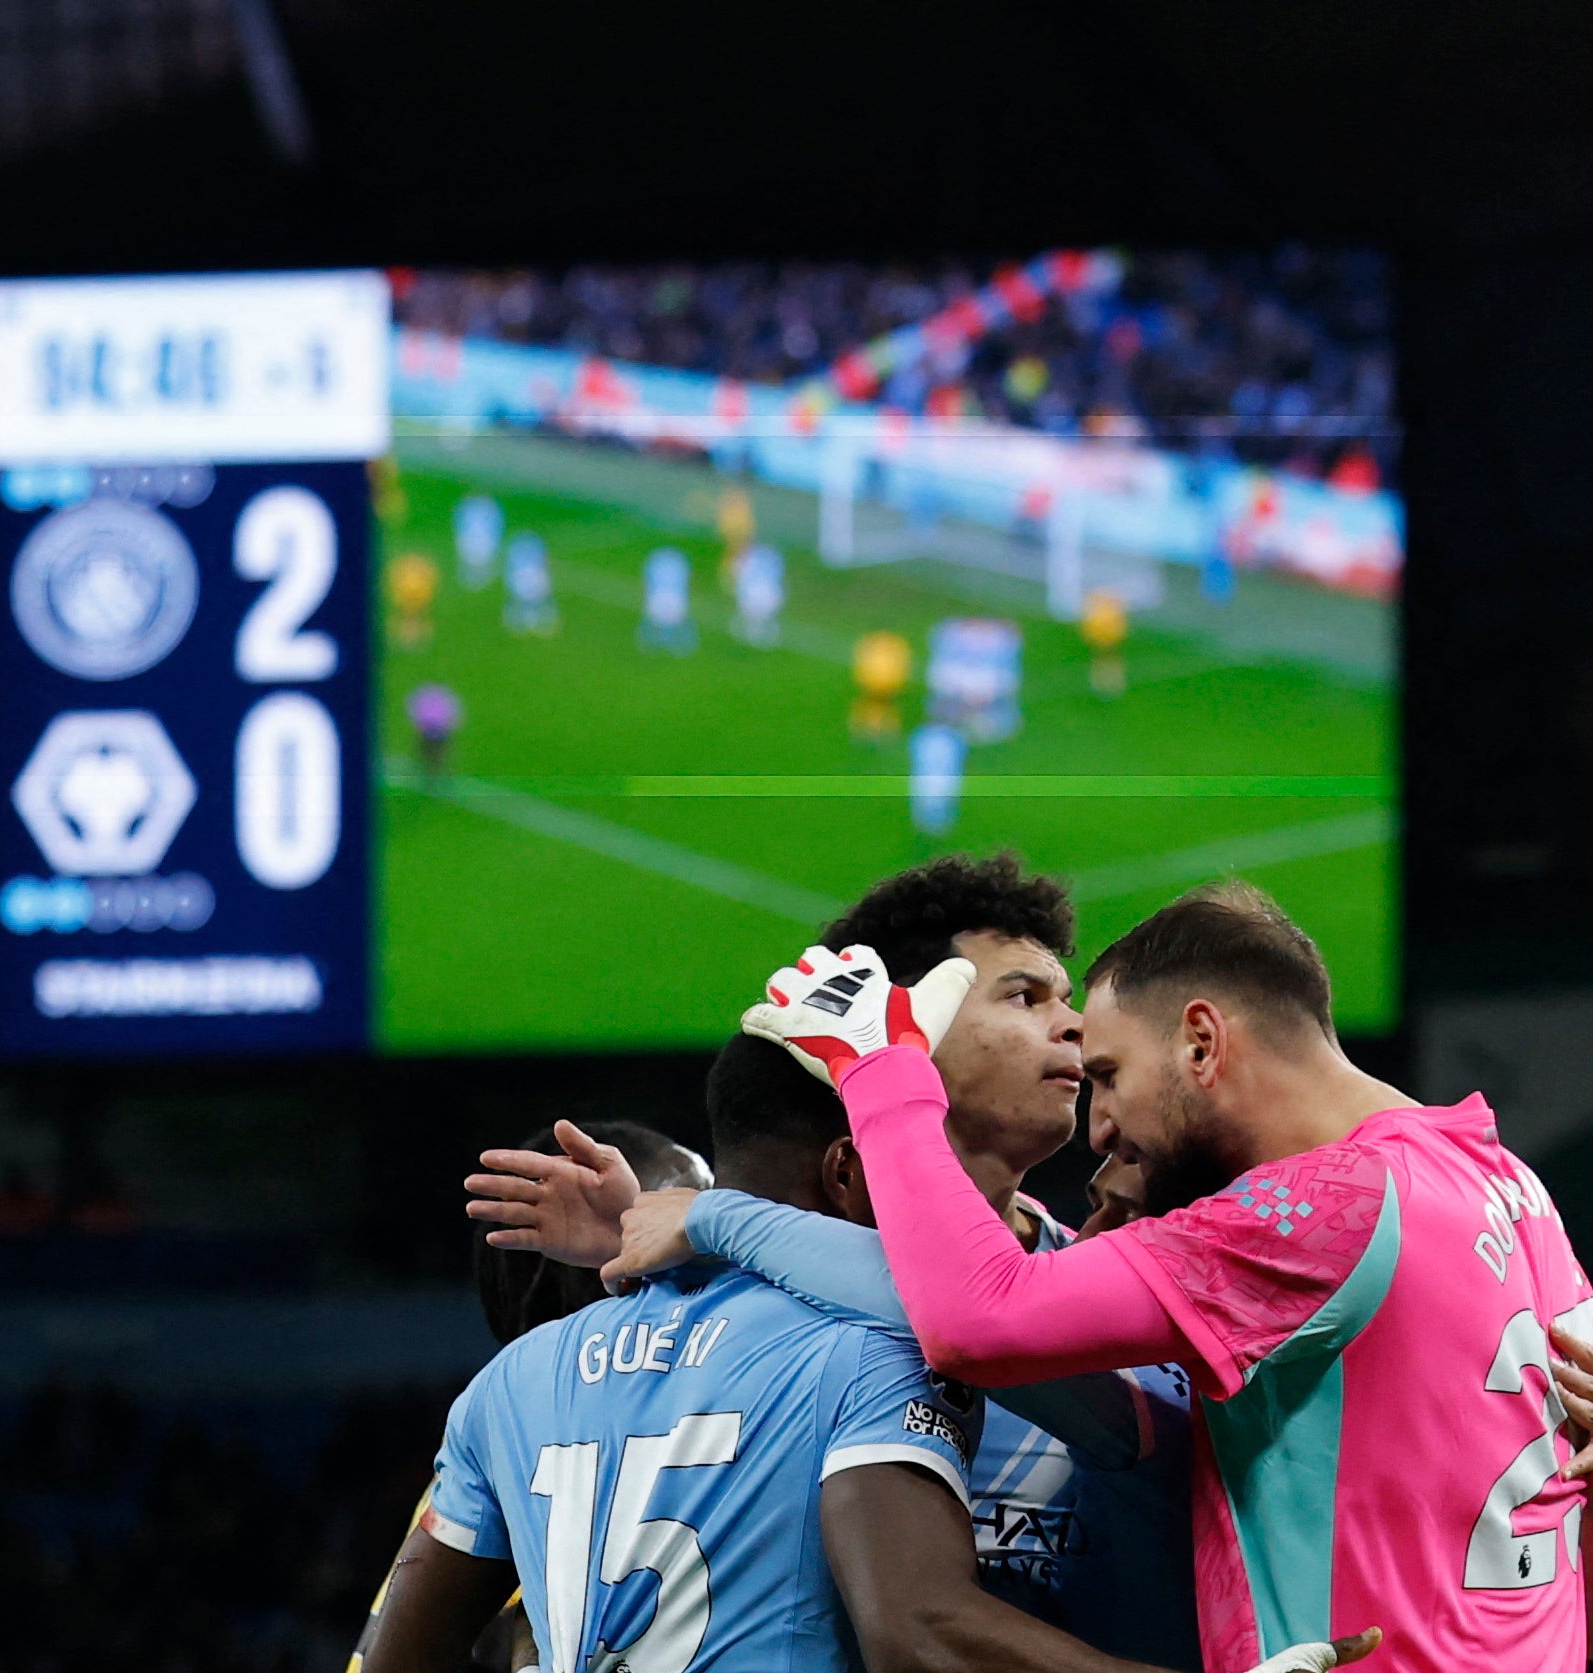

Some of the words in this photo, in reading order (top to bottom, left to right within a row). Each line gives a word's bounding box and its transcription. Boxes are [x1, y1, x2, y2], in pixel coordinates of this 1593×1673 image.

[233, 486, 338, 684] 2
[235, 690, 342, 890] 0
[905, 1400, 933, 1421] No
